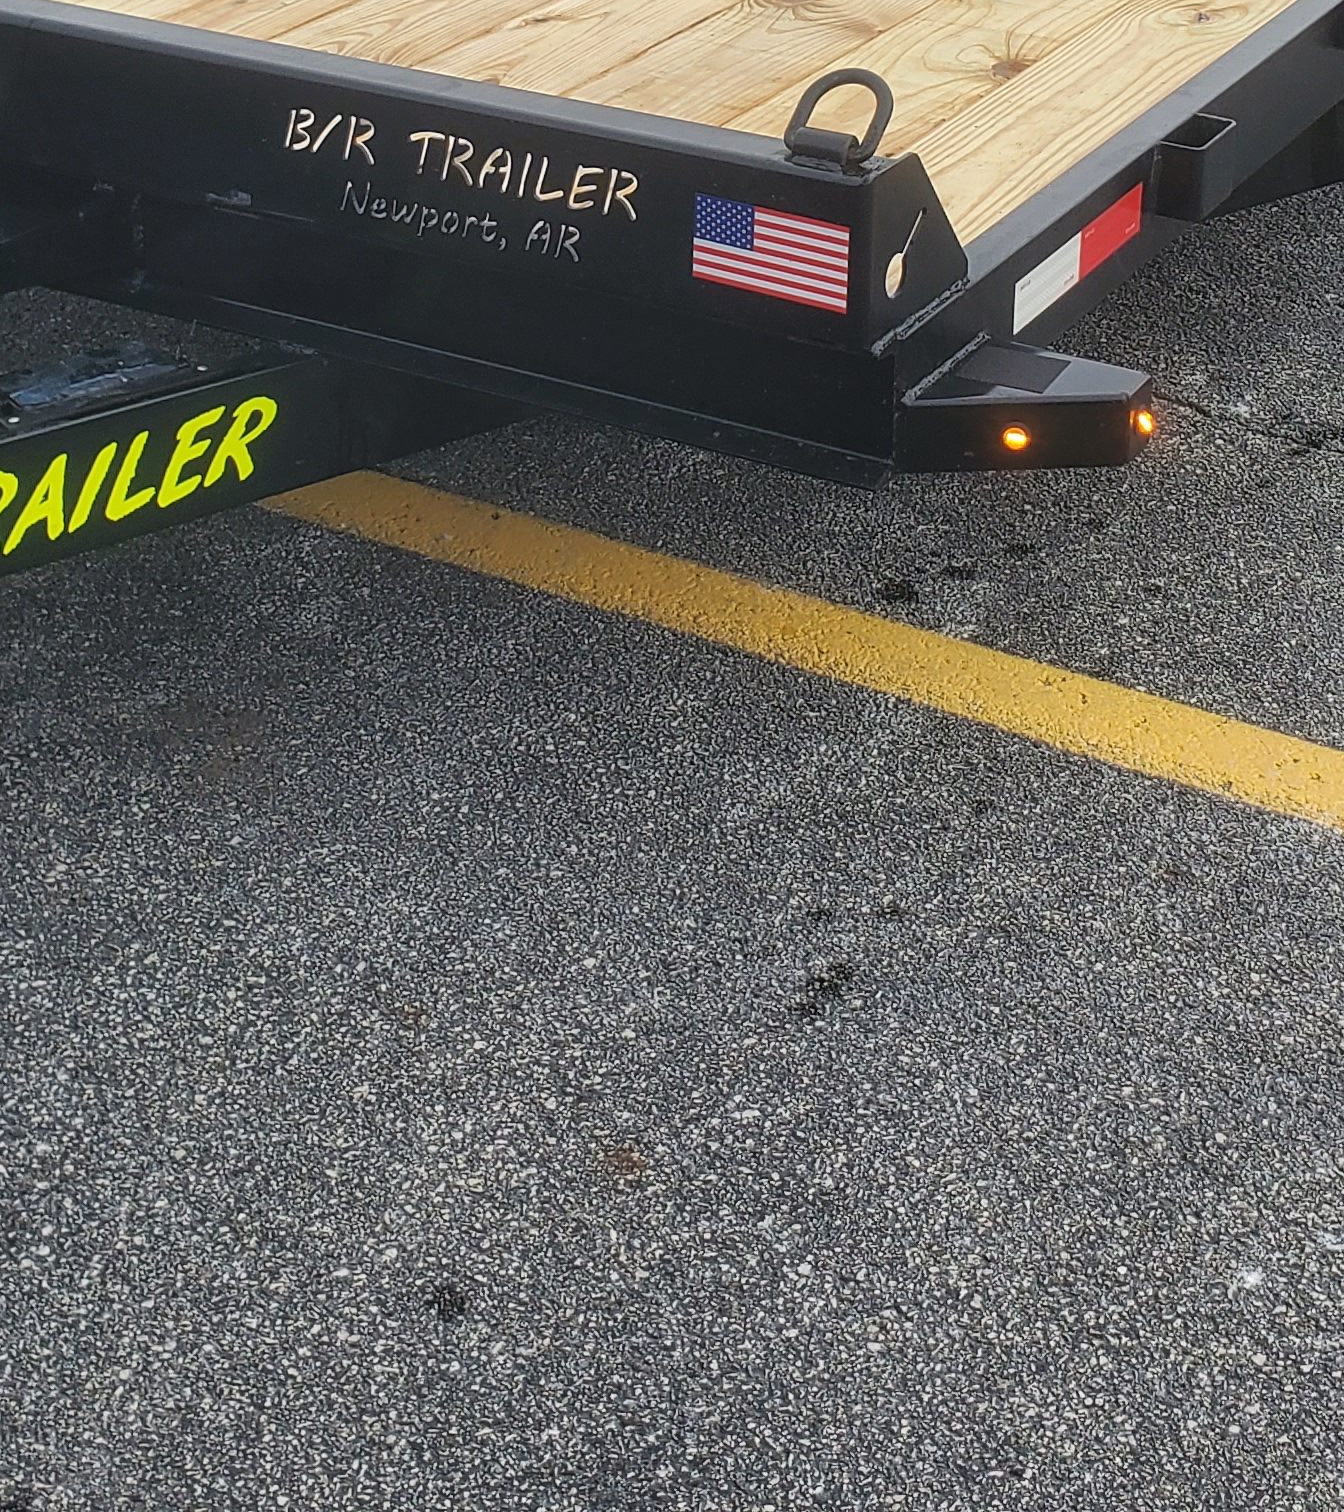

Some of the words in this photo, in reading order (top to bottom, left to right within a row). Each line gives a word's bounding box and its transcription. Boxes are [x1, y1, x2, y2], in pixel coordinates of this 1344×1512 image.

[283, 108, 375, 165] B/R
[409, 131, 639, 221] TRAILER
[340, 180, 507, 250] Newport,
[525, 219, 580, 263] AR
